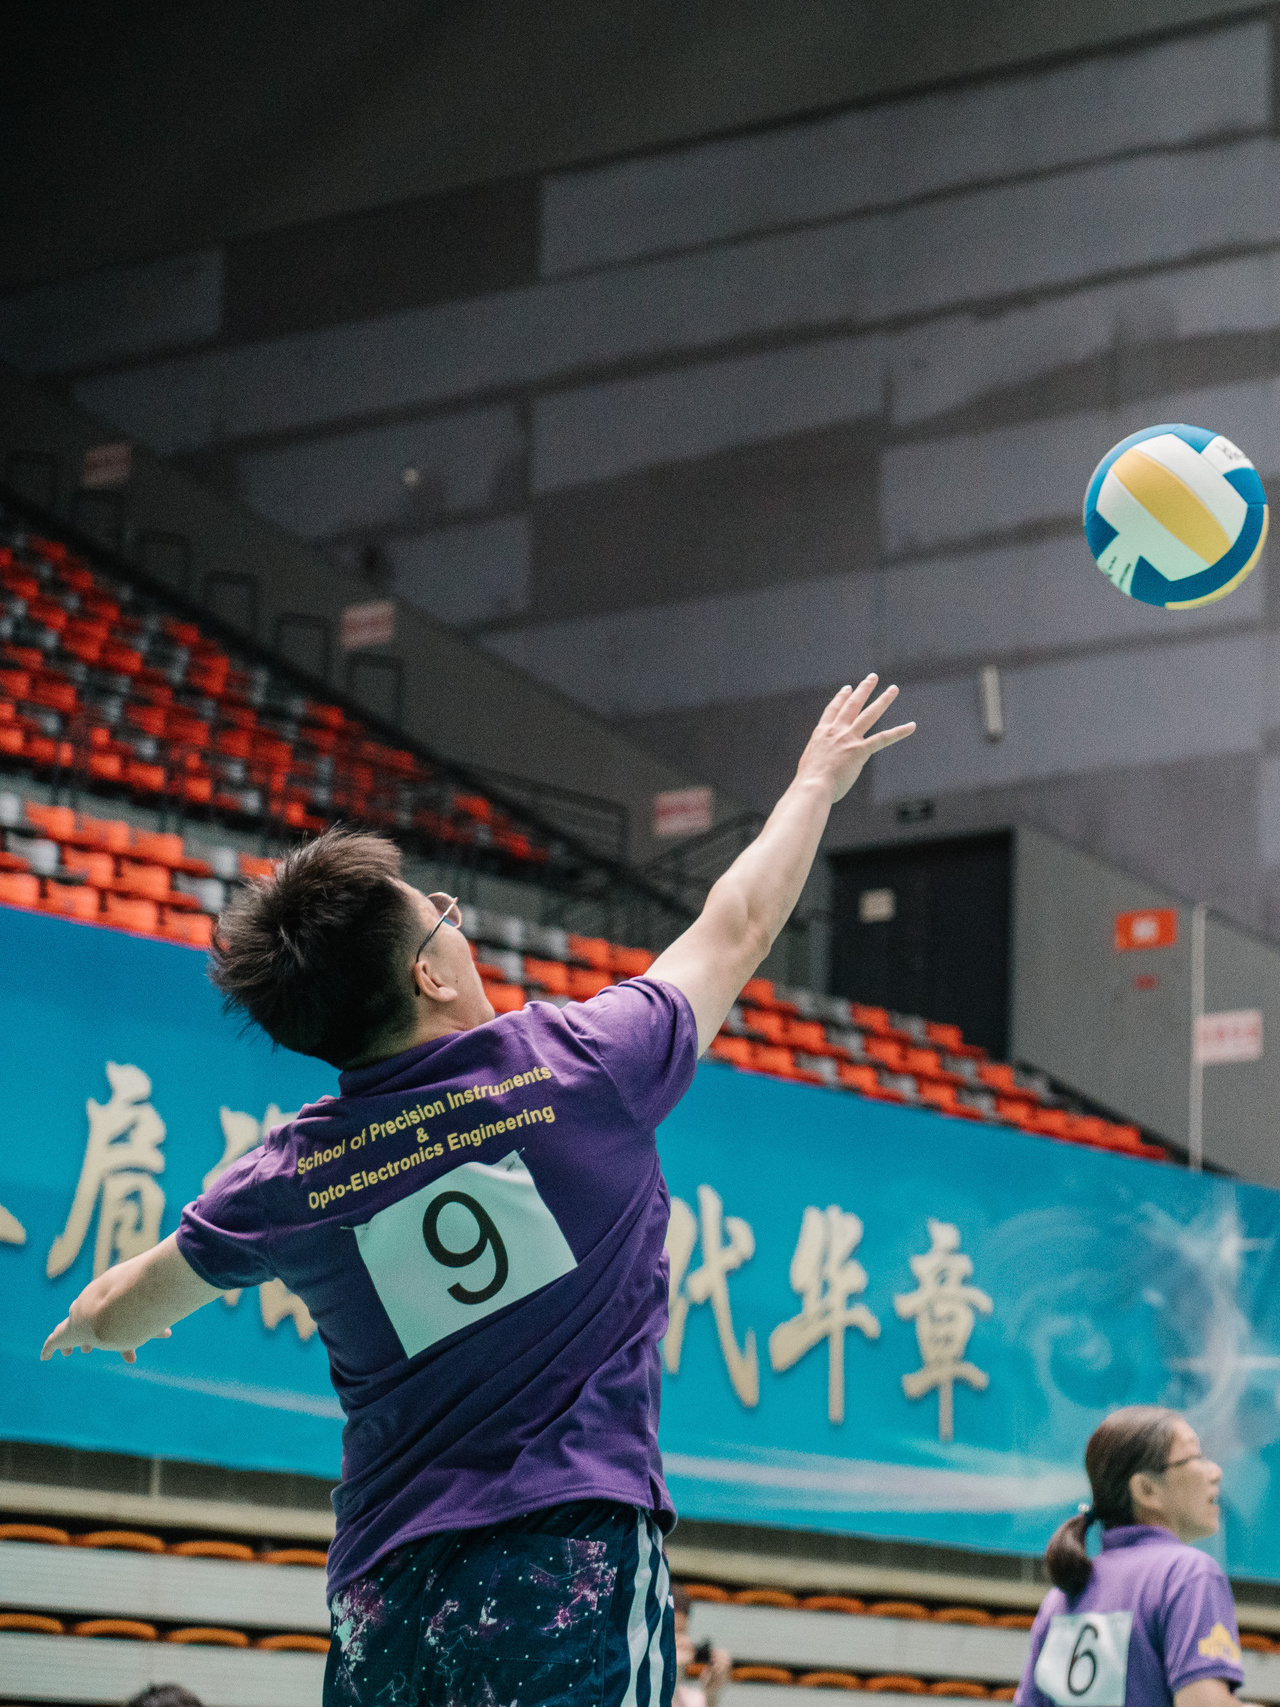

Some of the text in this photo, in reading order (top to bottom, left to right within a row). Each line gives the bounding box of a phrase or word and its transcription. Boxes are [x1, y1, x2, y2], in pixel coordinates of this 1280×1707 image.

[297, 1064, 552, 1176] School of Precision Instruments
[308, 1104, 556, 1210] Opto-Electronics Engineering
[416, 1127, 430, 1143] &
[422, 1190, 509, 1306] 9
[1067, 1622, 1099, 1697] 6
